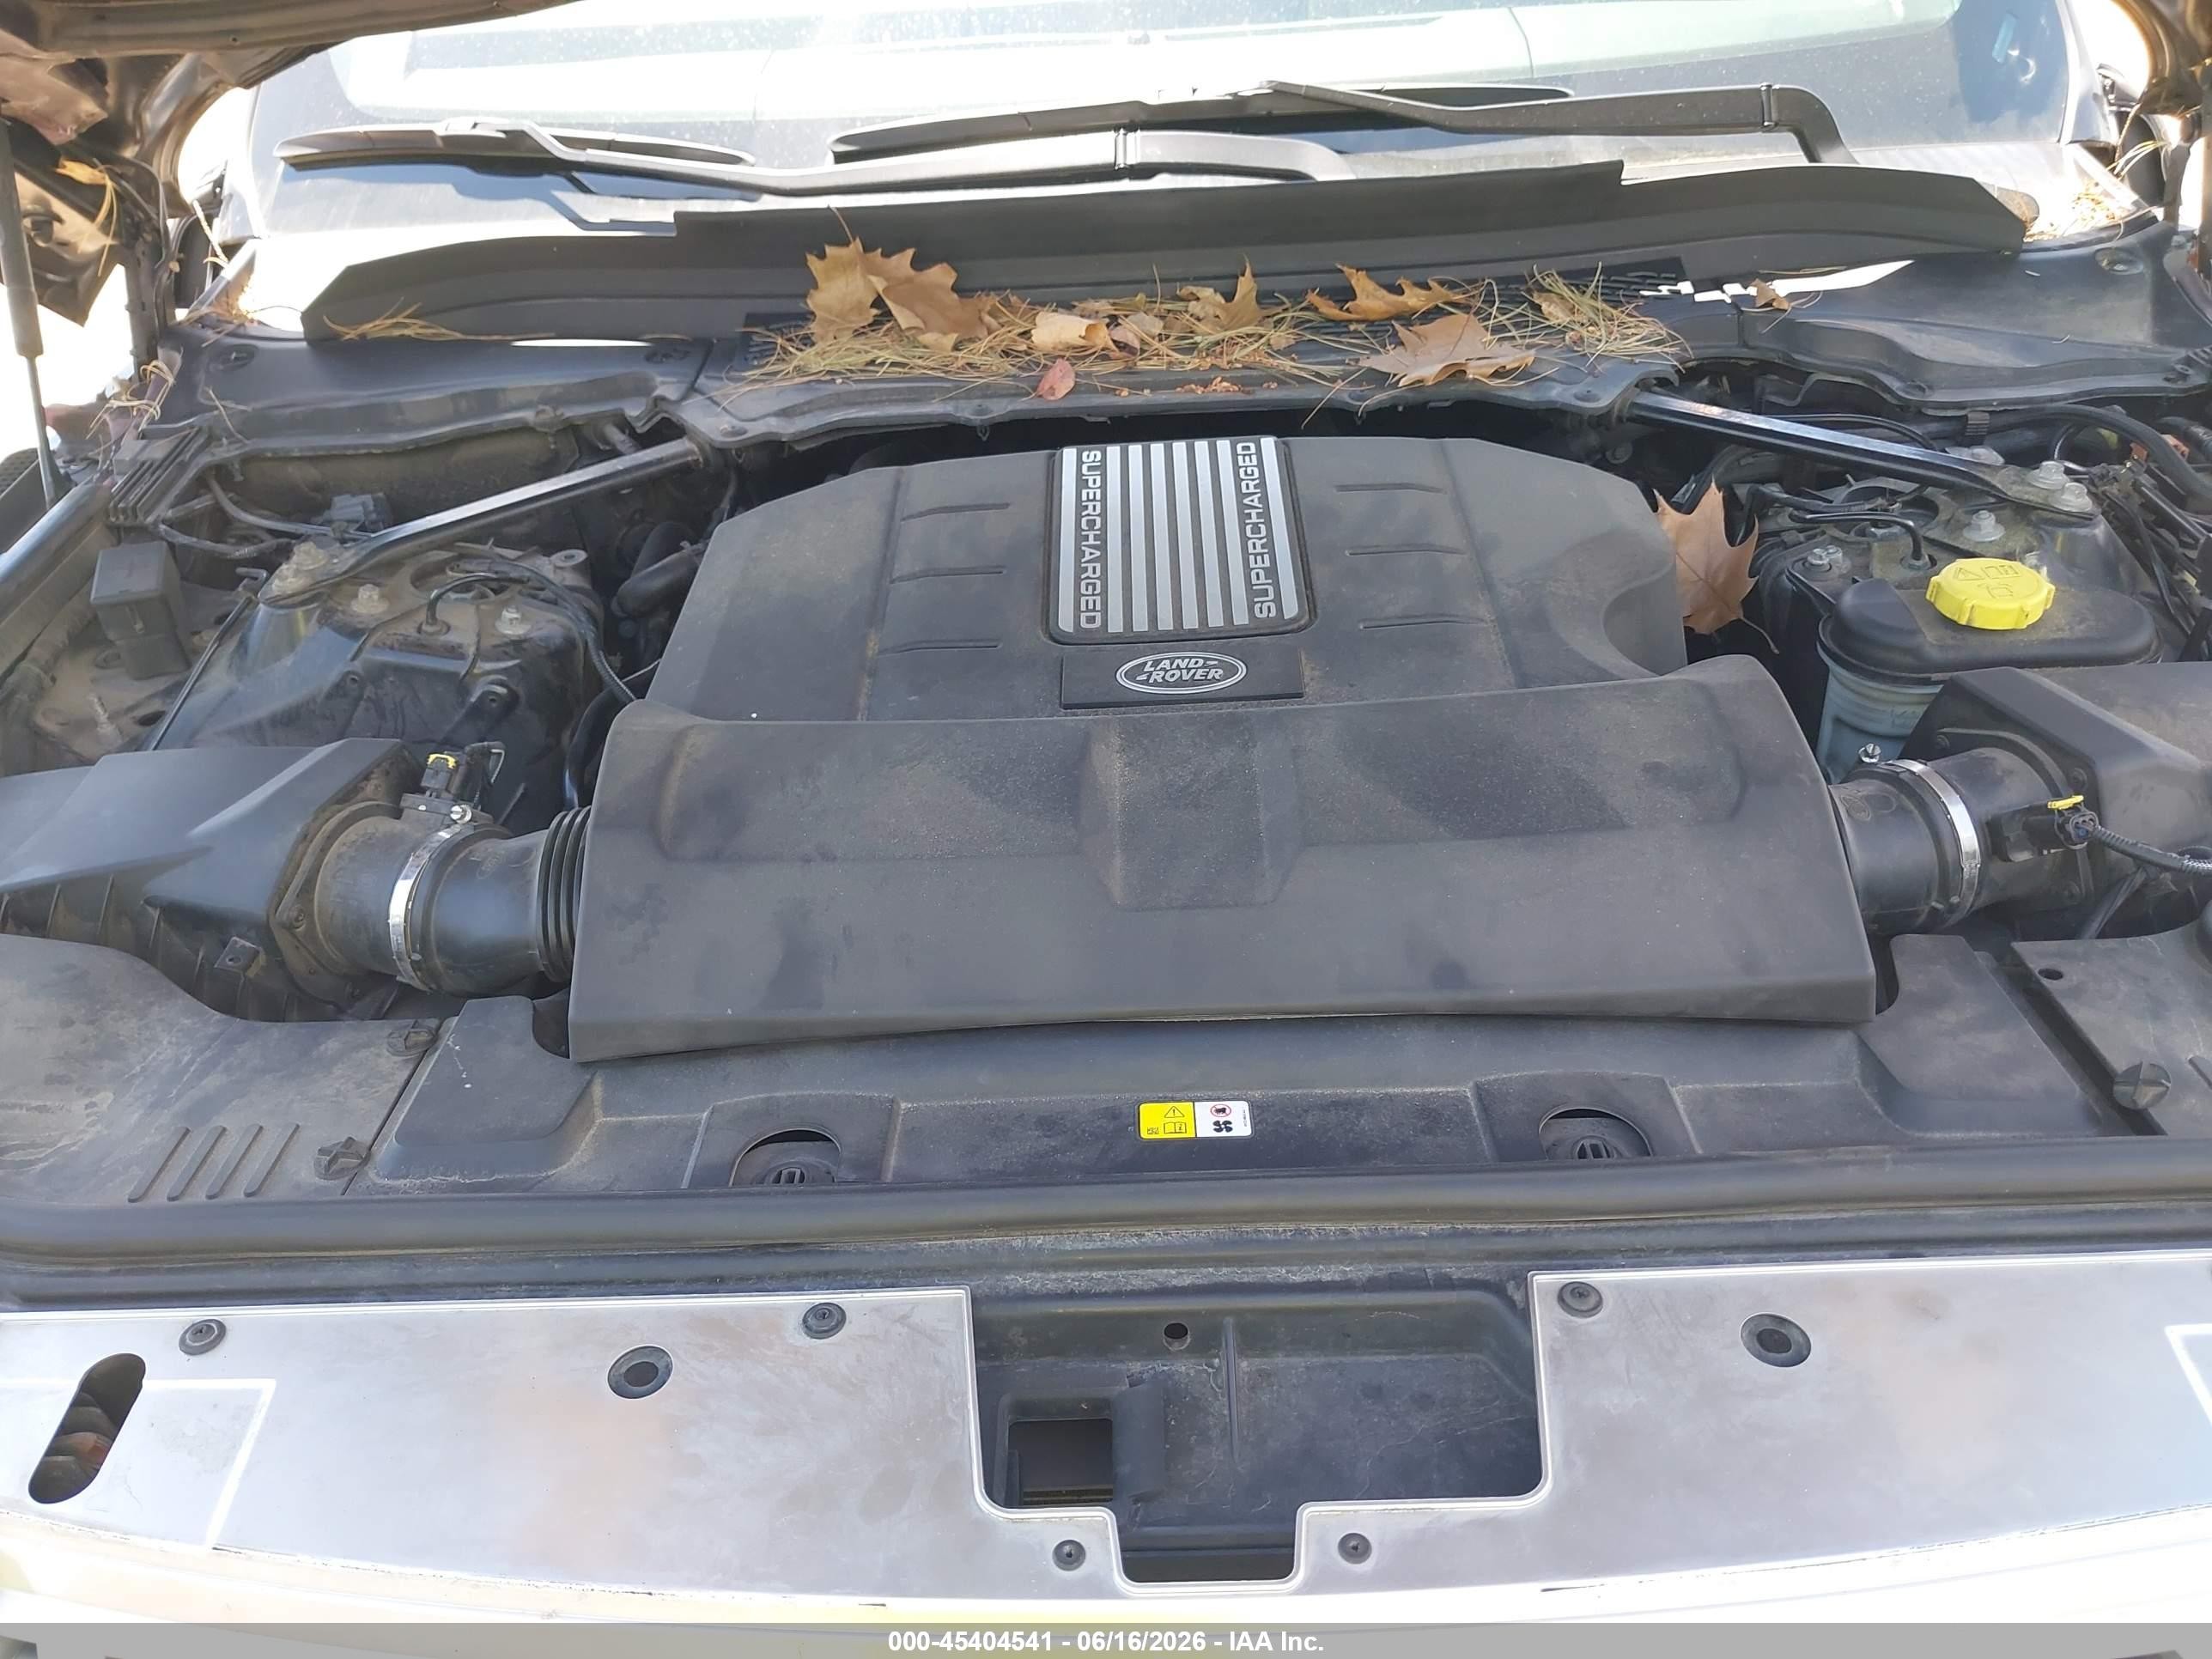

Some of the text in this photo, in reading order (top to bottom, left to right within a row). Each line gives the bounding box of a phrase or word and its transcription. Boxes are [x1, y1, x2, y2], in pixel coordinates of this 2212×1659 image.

[1080, 450, 1102, 629] SUPERCHARGED
[1237, 441, 1276, 618] SUPERCHARGED
[1144, 658, 1203, 672] LAND
[1149, 668, 1223, 684] ROVER
